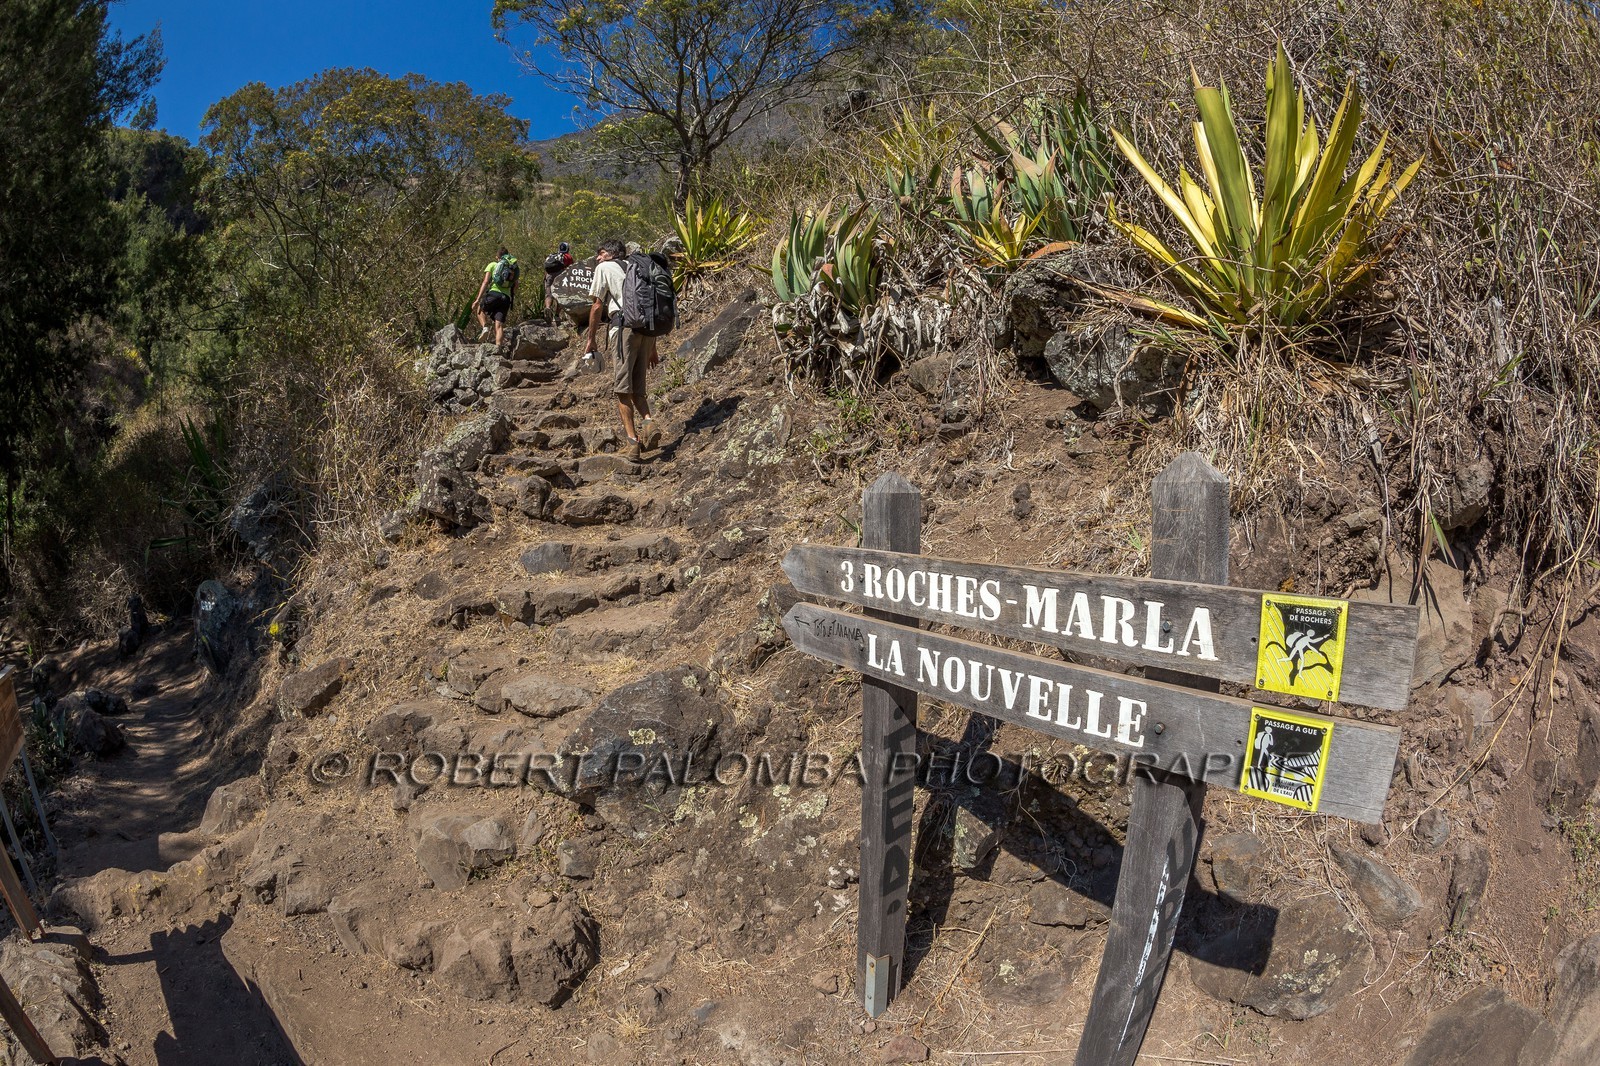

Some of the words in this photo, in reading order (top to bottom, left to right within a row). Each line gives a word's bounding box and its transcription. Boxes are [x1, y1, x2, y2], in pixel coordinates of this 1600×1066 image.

[840, 560, 854, 593] 3
[1289, 614, 1299, 622] DE
[1300, 616, 1332, 625] ROCHERS
[1295, 607, 1327, 617] PASSAGE
[867, 633, 905, 677] LA
[917, 647, 1148, 748] NOUVELLE
[1264, 719, 1295, 731] PASSAGE
[1302, 727, 1318, 736] GUE
